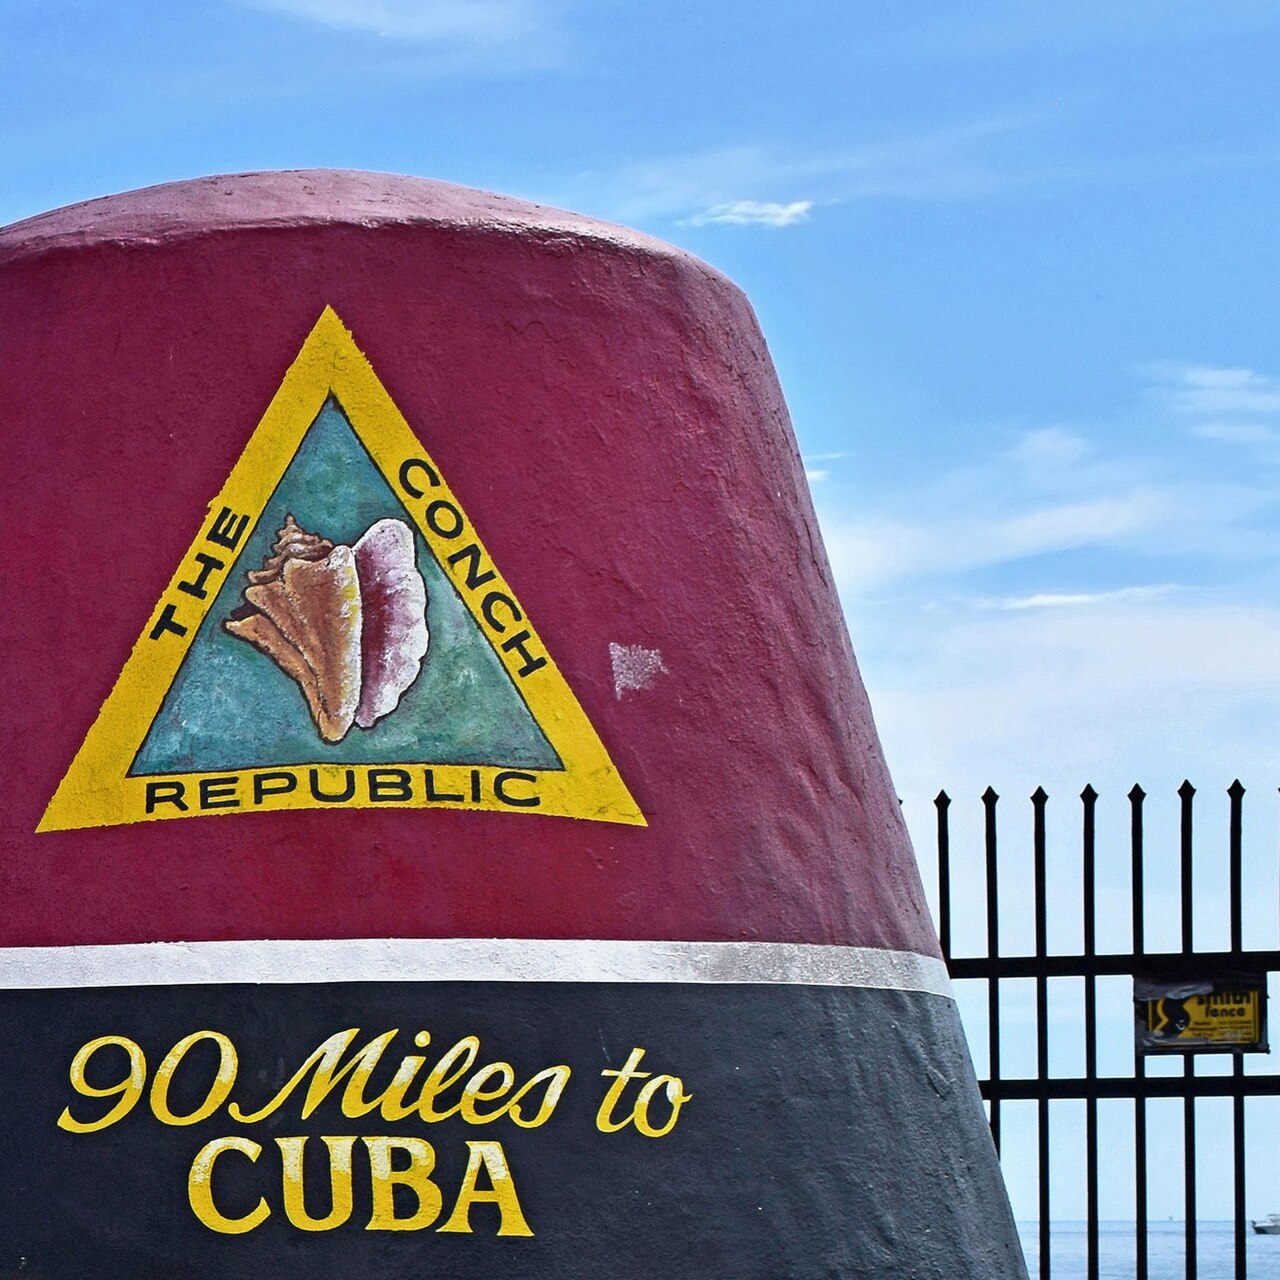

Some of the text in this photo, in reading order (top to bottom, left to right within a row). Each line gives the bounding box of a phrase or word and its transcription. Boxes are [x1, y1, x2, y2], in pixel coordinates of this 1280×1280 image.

[149, 505, 251, 641] THE
[397, 456, 547, 680] CONCH
[144, 766, 541, 814] REPUBLIC
[1205, 1006, 1246, 1018] fence
[57, 1028, 693, 1138] 90 Miles to
[187, 1135, 535, 1237] CUBA
